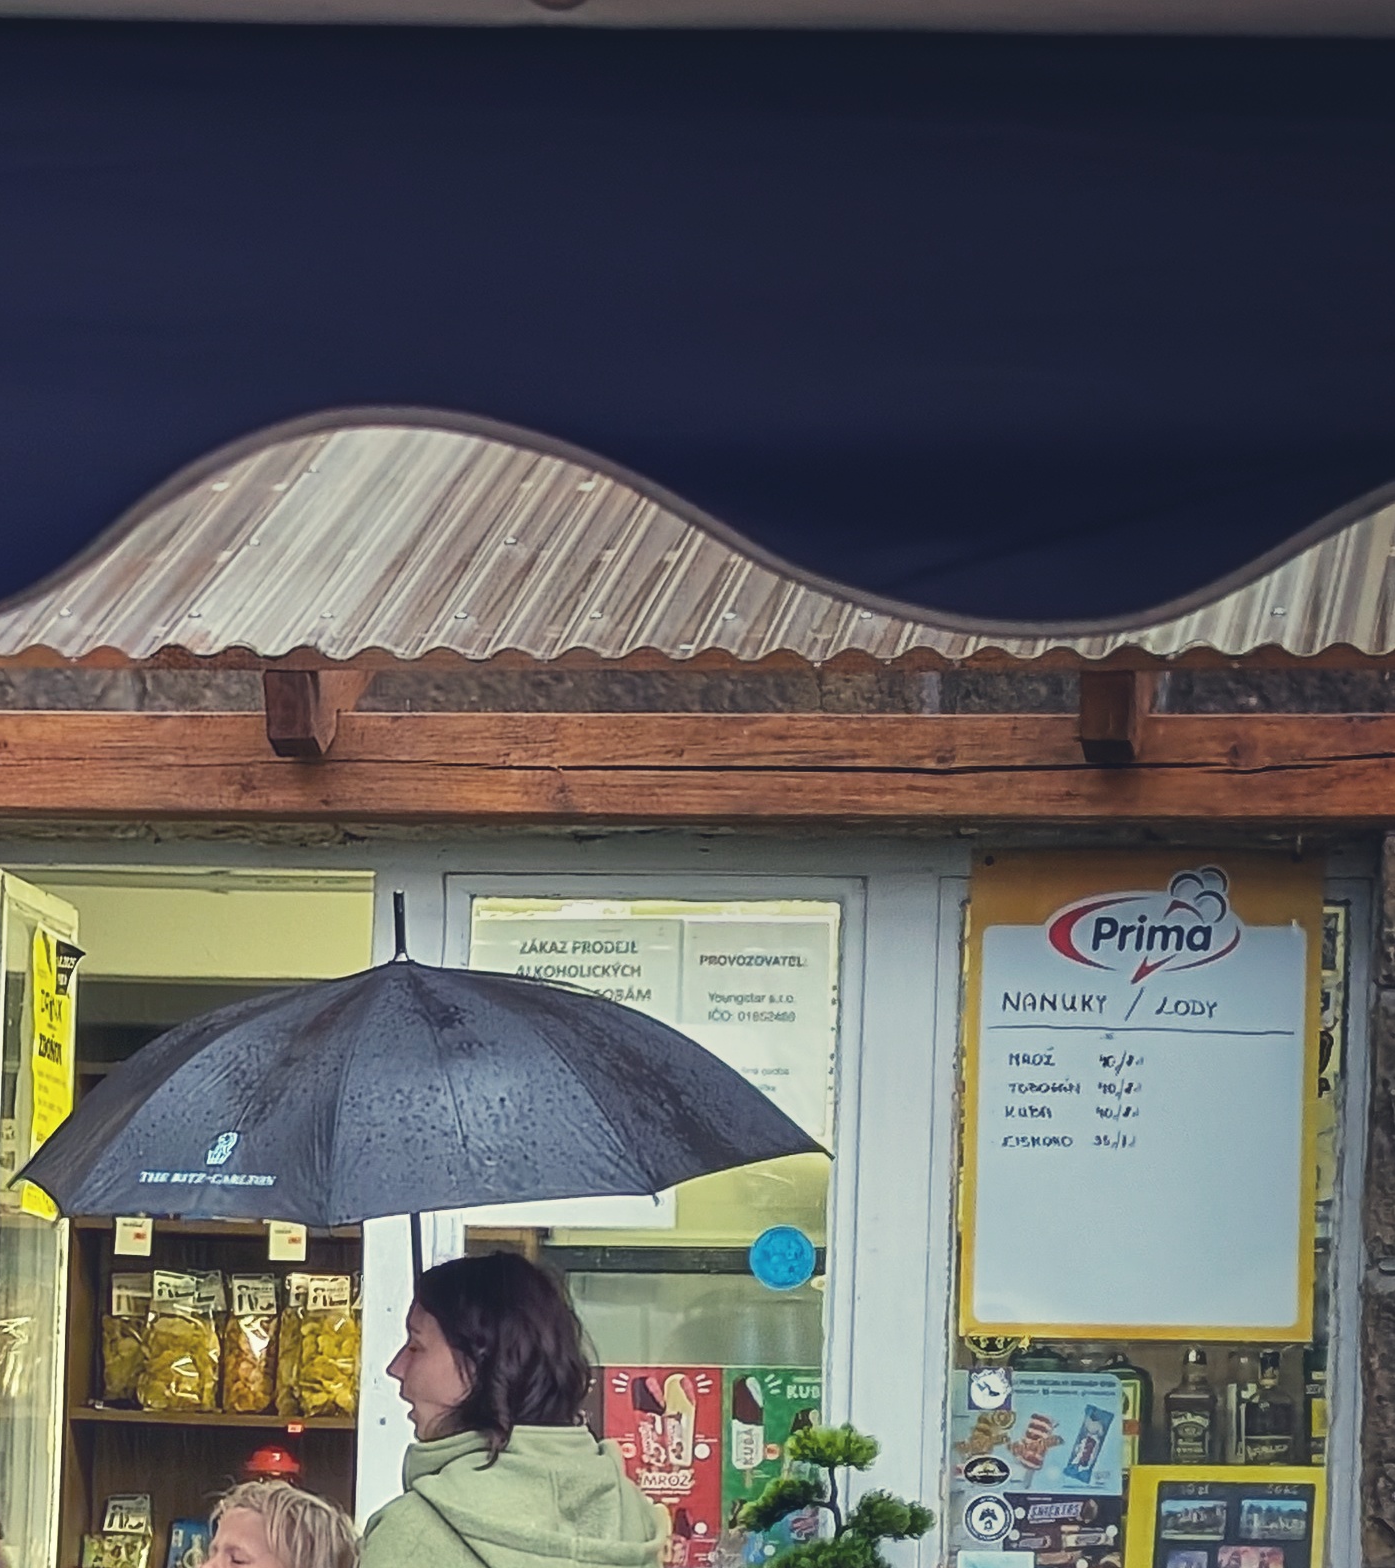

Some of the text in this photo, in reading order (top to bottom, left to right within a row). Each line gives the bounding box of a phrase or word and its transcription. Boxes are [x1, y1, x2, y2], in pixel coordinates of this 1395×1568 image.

[519, 938, 567, 954] ZÁKAZ
[1092, 915, 1213, 952] Prima
[1002, 992, 1107, 1014] NANUKY
[1154, 997, 1217, 1018] LODY
